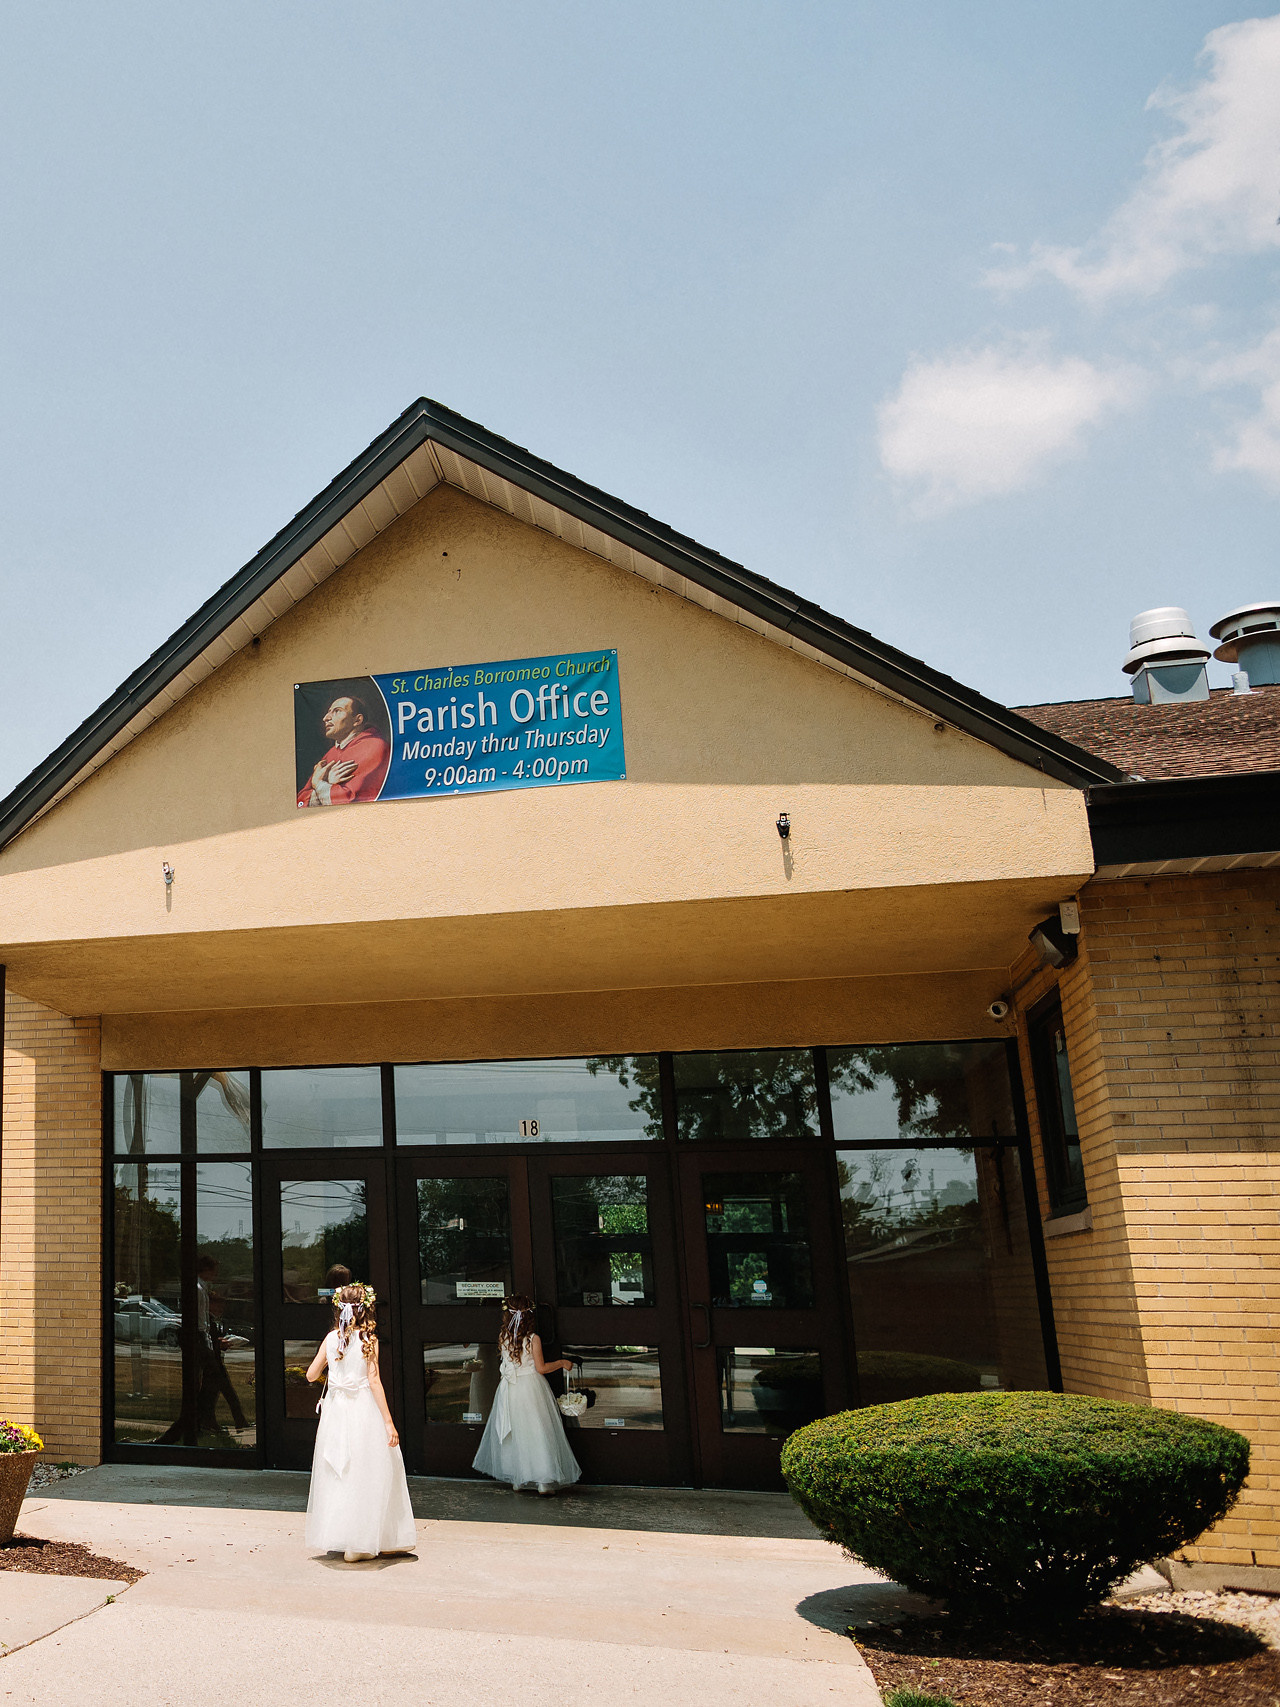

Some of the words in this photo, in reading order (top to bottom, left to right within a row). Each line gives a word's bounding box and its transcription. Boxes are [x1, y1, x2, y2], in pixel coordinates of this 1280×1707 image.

[391, 679, 409, 694] St.
[414, 672, 470, 692] Charles
[474, 667, 551, 686] Borromeo
[555, 656, 610, 677] Church
[398, 692, 498, 734] Parish
[510, 683, 609, 723] Office
[402, 736, 477, 760] Monday
[481, 733, 519, 753] thru
[525, 724, 610, 749] Thursday
[425, 765, 496, 787] 9:00am
[512, 757, 589, 781] 4:00pm
[521, 1120, 539, 1136] 18
